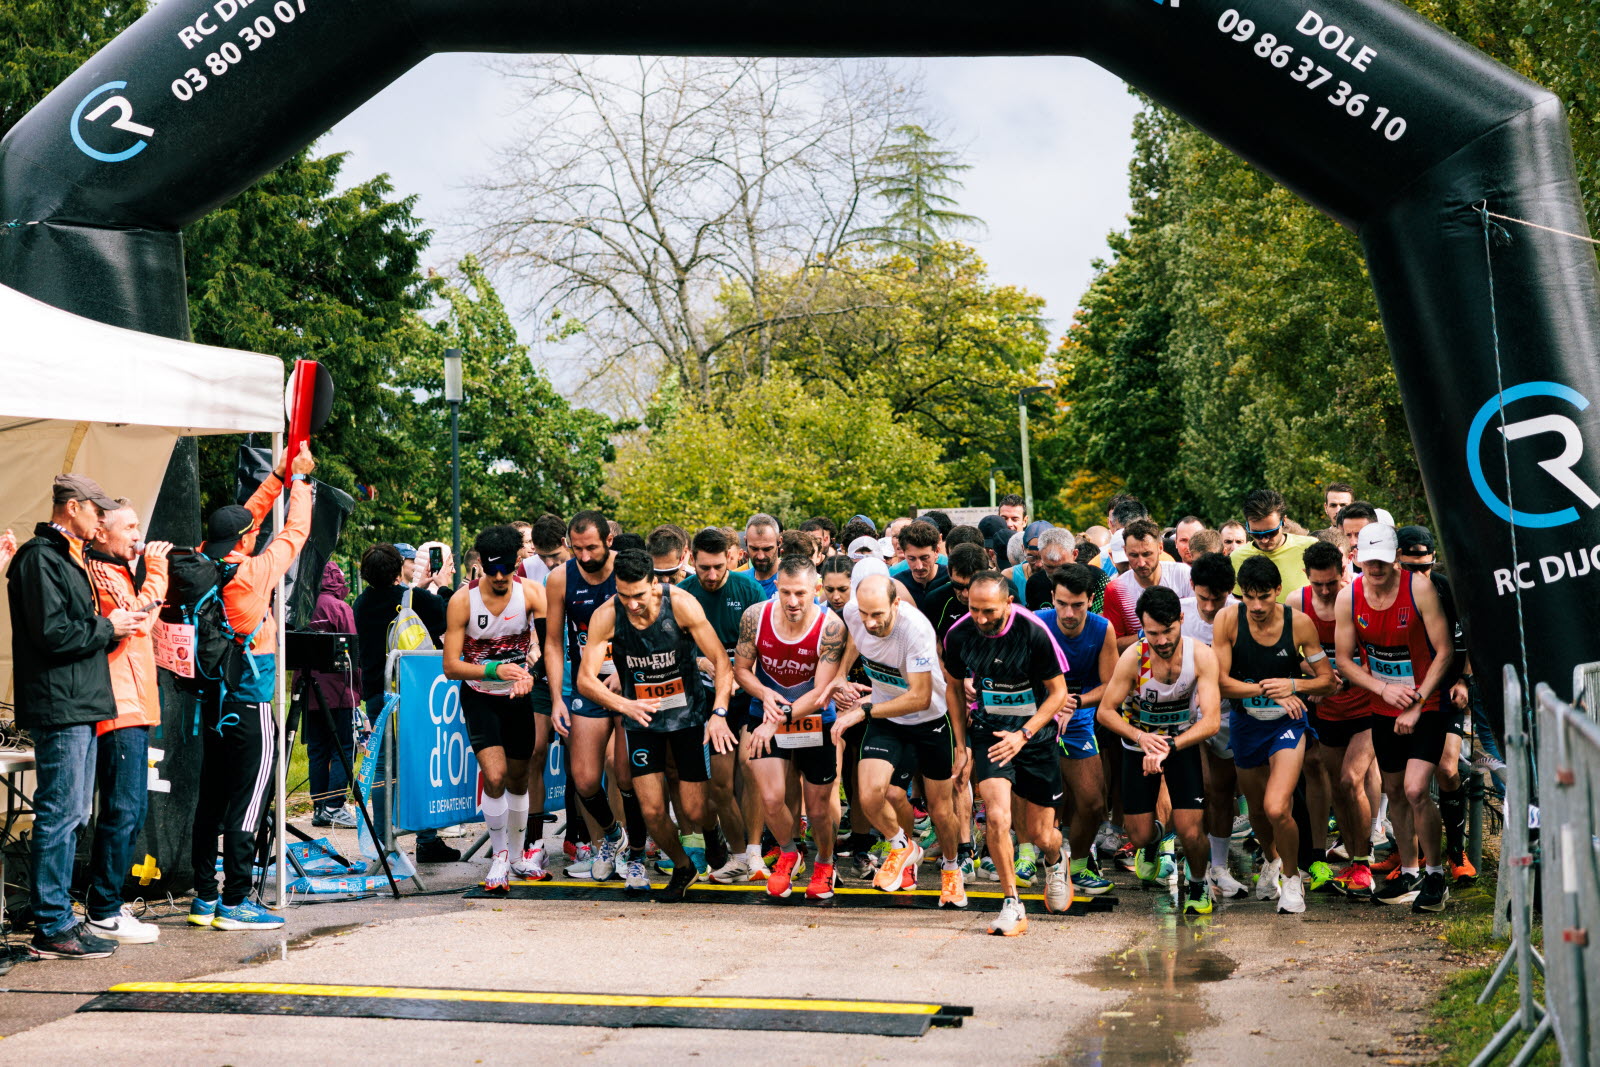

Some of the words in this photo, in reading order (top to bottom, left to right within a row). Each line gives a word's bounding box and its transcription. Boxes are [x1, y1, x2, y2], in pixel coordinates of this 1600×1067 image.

[177, 12, 218, 50] RC
[213, 0, 255, 22] DI
[1295, 9, 1378, 73] DOLE
[171, 67, 208, 101] 03
[205, 41, 242, 76] 80
[238, 15, 276, 51] 30
[1217, 8, 1255, 42] 09
[1254, 32, 1294, 68] 86
[1290, 56, 1333, 90] 37
[1327, 80, 1370, 117] 36
[1370, 106, 1407, 142] 10
[1493, 561, 1535, 596] RC
[626, 650, 676, 669] ATHLETIC
[762, 655, 815, 672] DIJON
[1375, 661, 1402, 675] 661
[870, 670, 899, 685] 600
[644, 683, 675, 698] 105
[992, 694, 1026, 705] 544
[1251, 695, 1279, 706] 67
[783, 718, 813, 732] 116
[1149, 713, 1180, 723] 599
[429, 800, 436, 814] LE
[436, 795, 472, 813] DÉPARTEMENT
